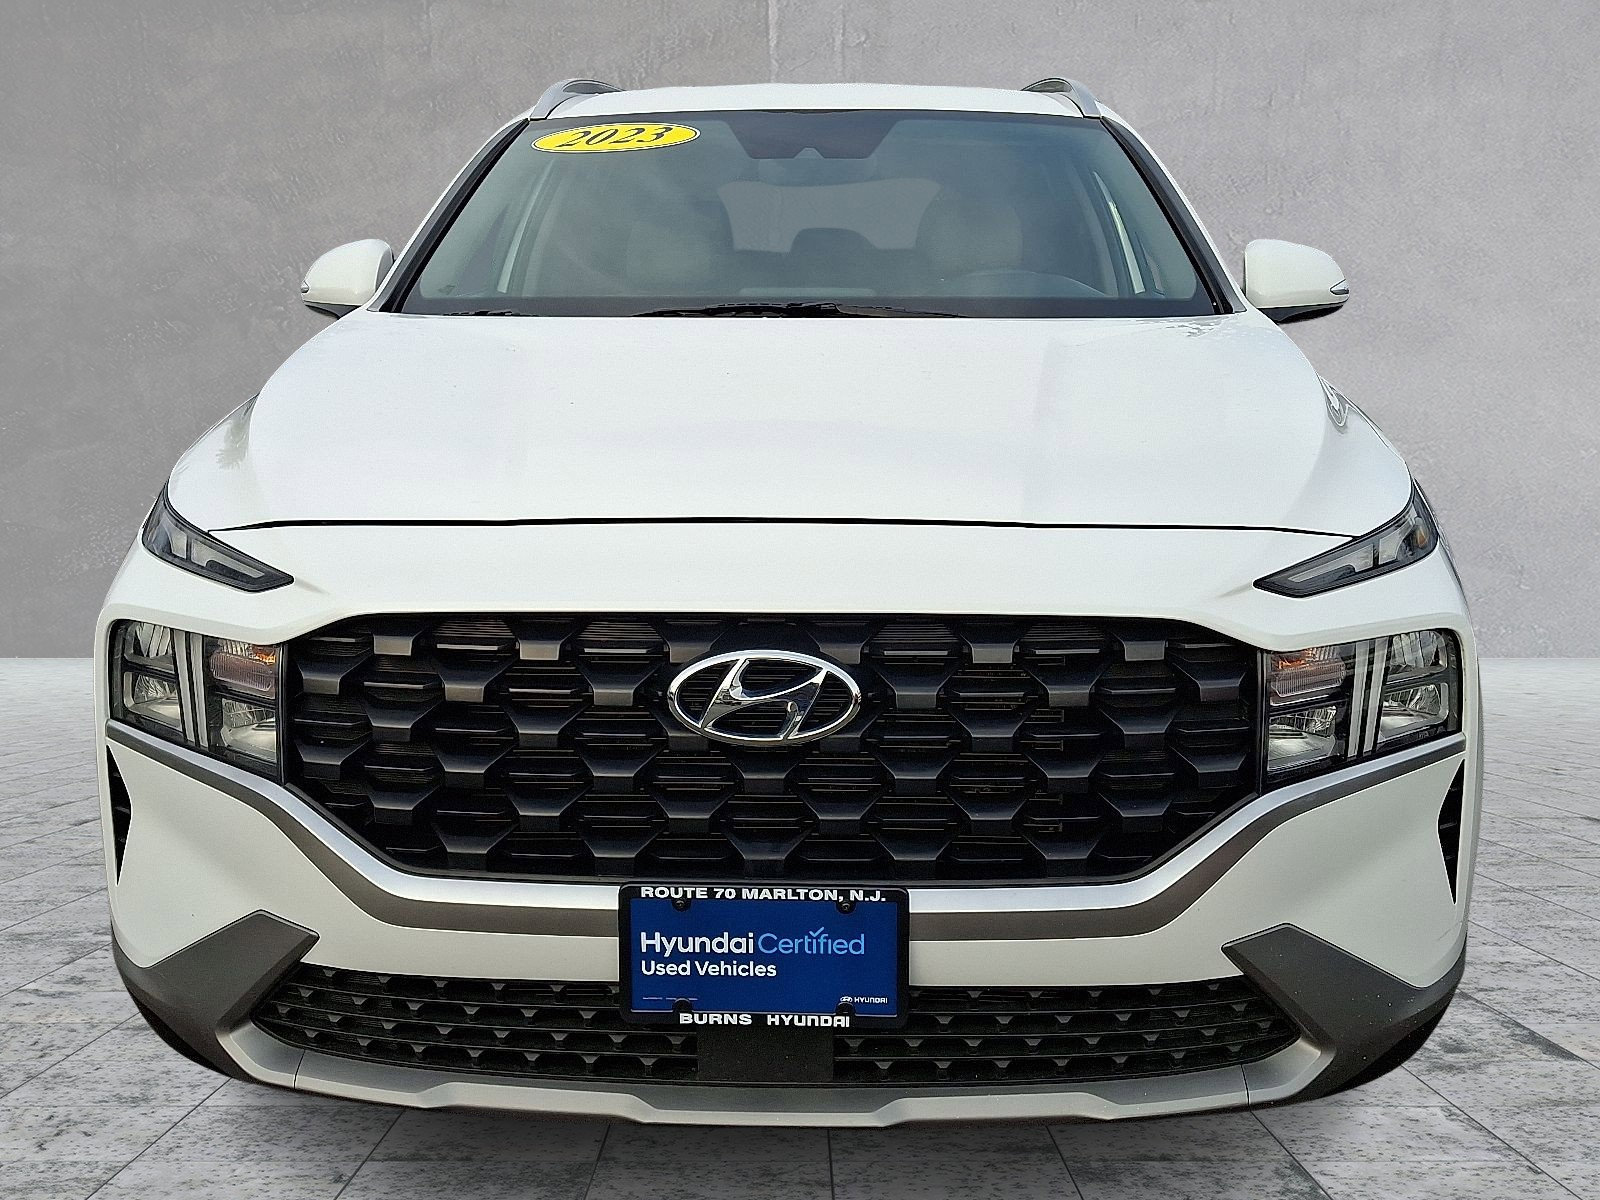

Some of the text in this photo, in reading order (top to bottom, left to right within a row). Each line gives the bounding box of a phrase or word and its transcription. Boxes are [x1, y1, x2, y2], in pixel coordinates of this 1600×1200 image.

[555, 127, 673, 148] 2023
[641, 887, 886, 902] ROUTE 70 MARLTON, N.J.
[641, 927, 865, 957] Hyundai Certified
[641, 960, 777, 977] Used Vehicles
[854, 996, 888, 1004] HYUNDAI
[680, 1013, 850, 1028] BURNS HYUNDAI
